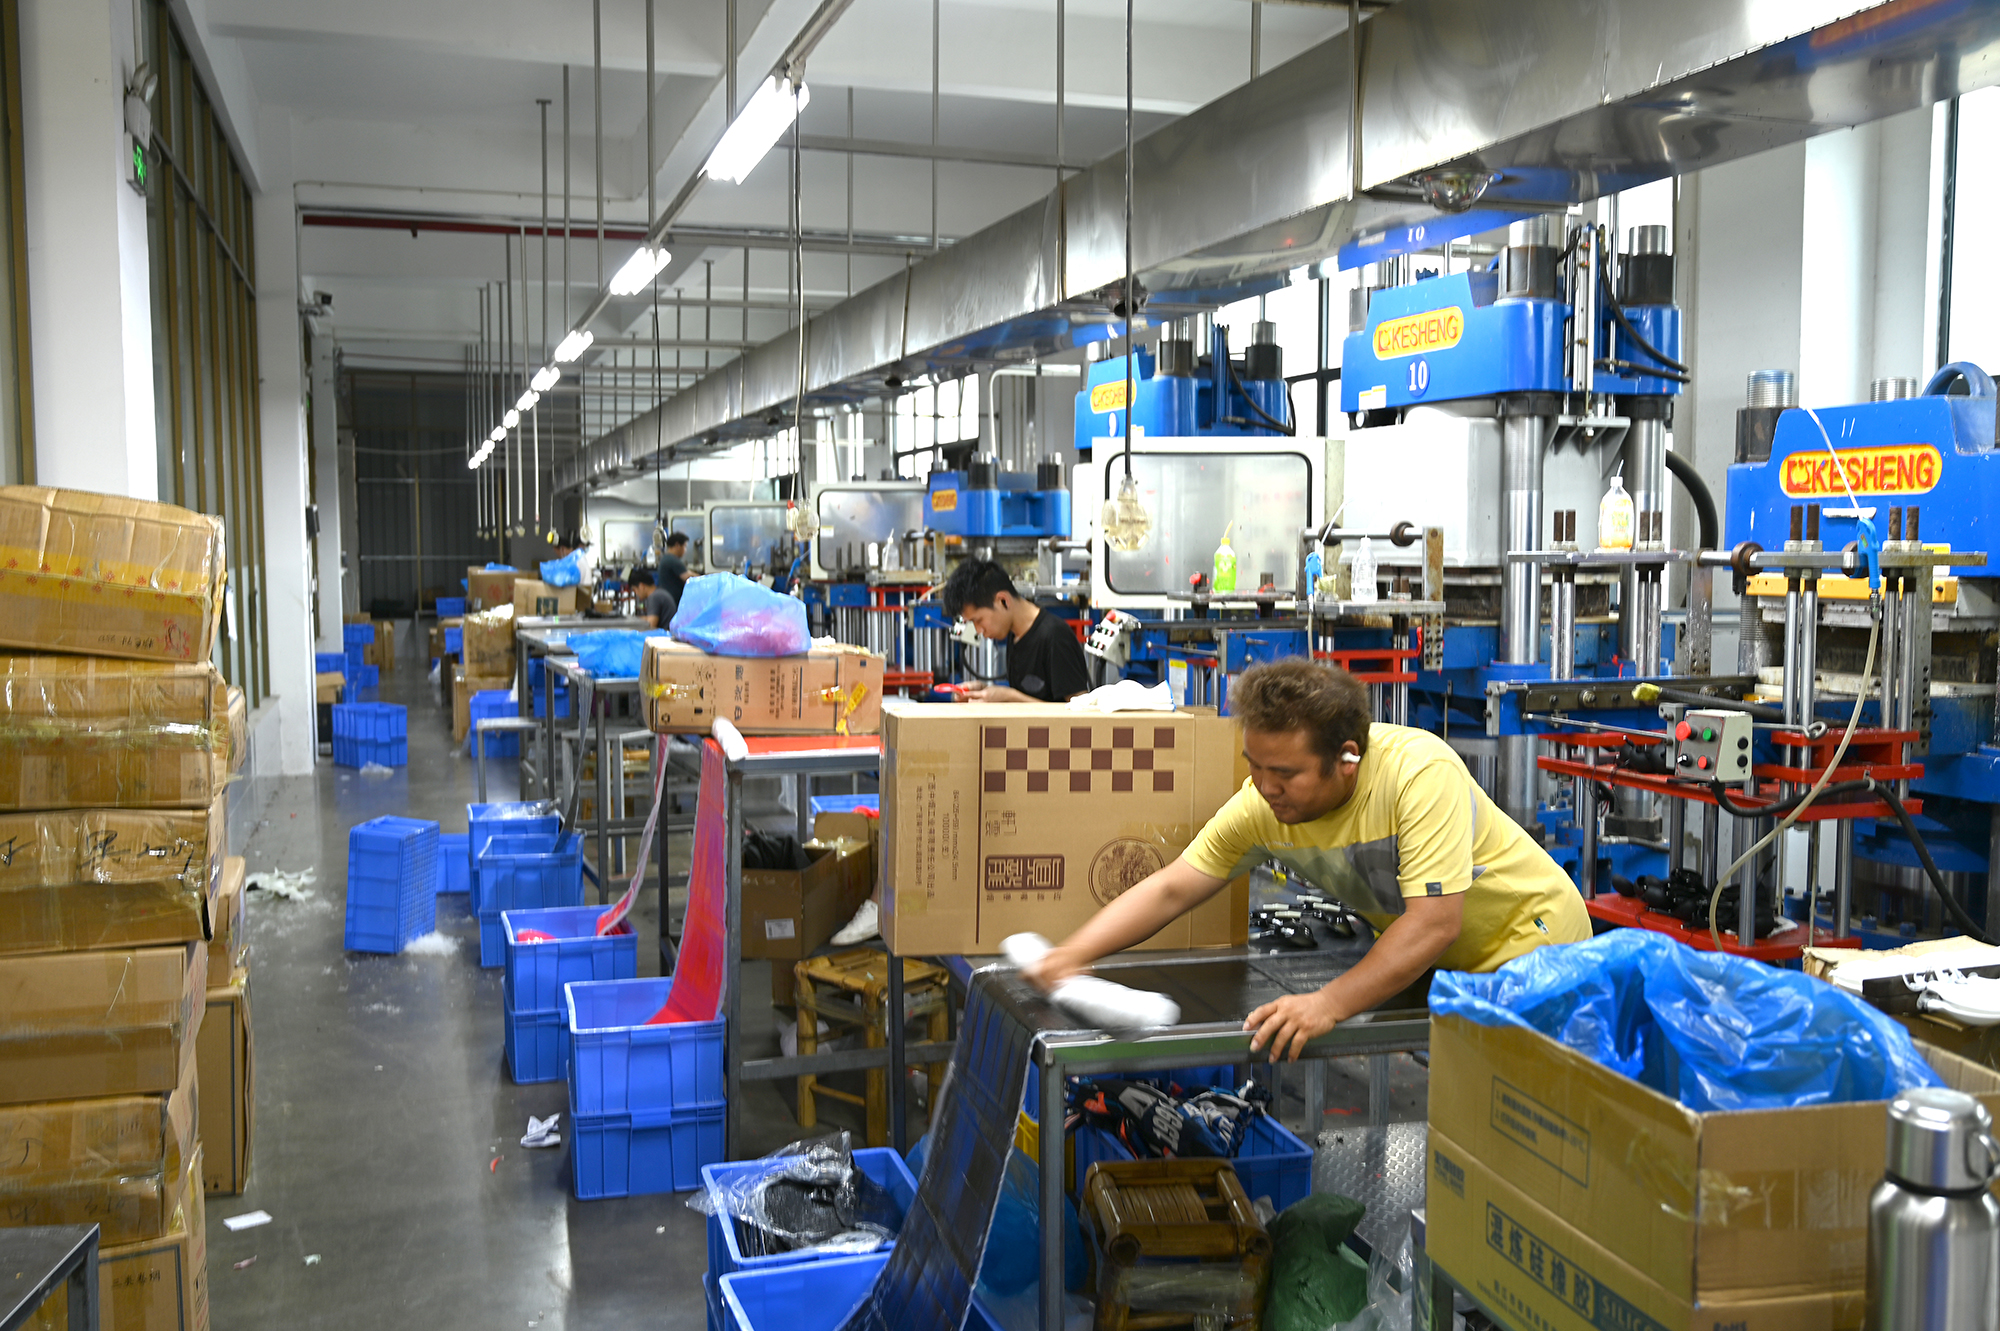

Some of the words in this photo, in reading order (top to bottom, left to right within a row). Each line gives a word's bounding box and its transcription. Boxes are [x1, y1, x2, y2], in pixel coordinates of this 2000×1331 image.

[1391, 314, 1459, 352] KESHENG
[1409, 360, 1428, 392] 10
[1811, 451, 1936, 494] KESHENG
[1490, 1212, 1590, 1315] 混炼硅橡胶
